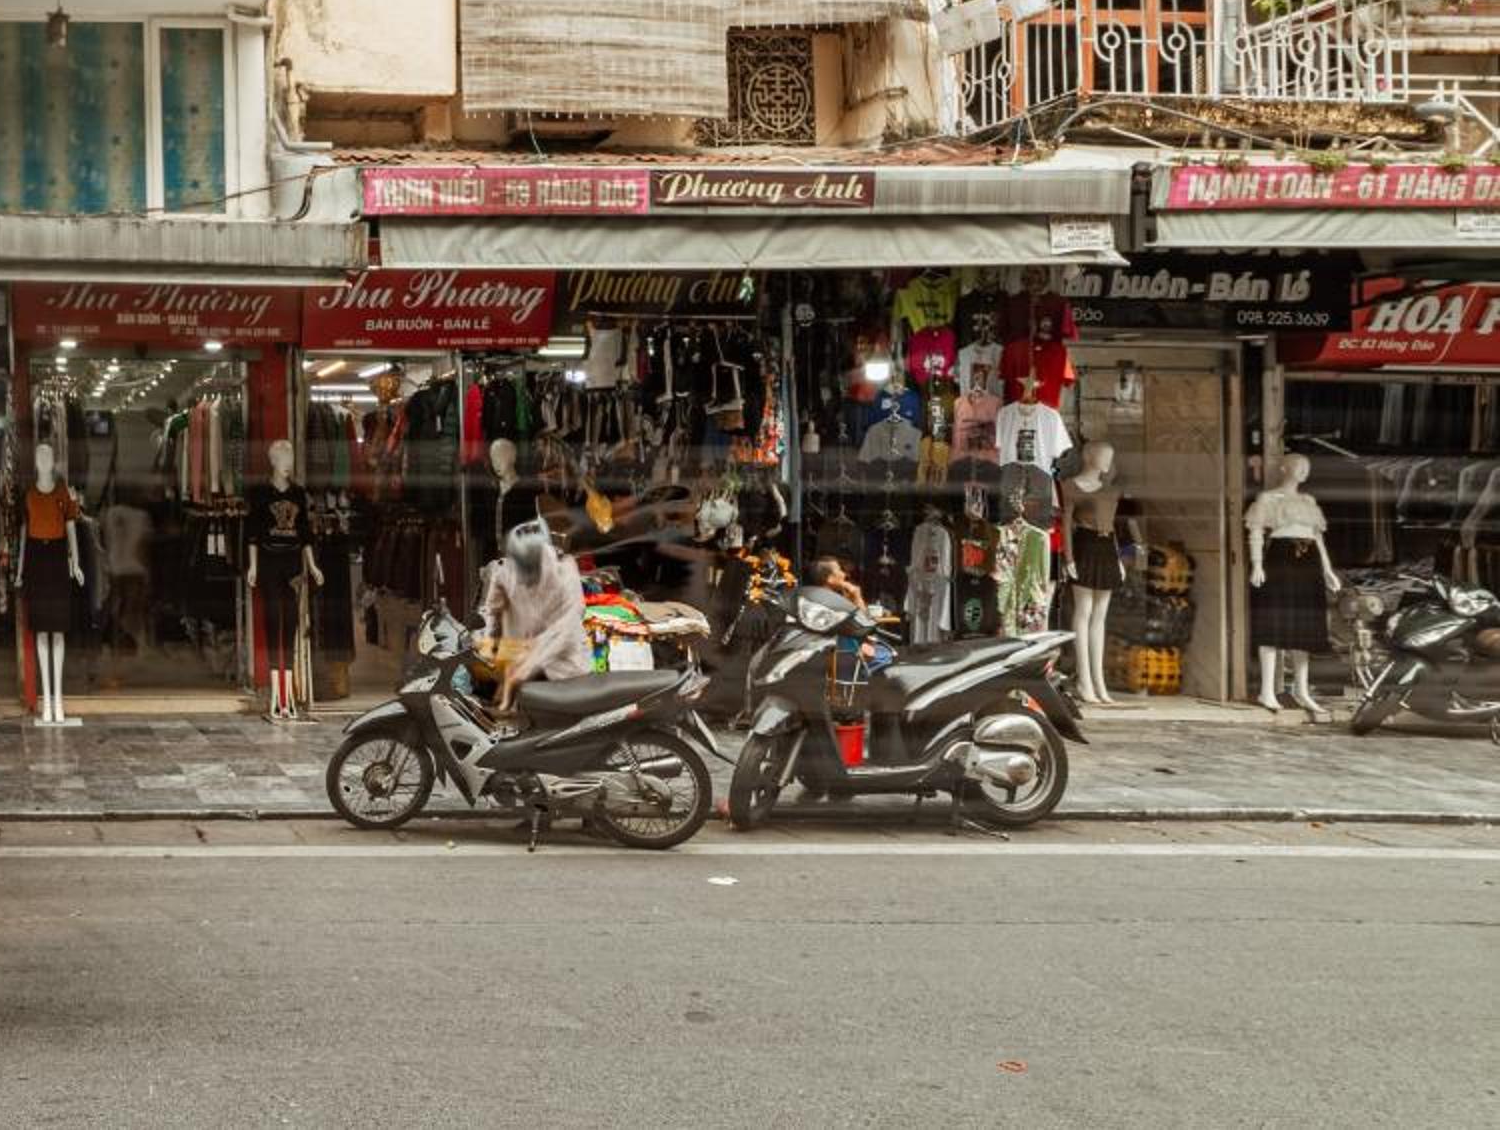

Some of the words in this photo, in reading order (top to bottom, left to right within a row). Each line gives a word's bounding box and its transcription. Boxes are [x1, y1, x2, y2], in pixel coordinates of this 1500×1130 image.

[659, 172, 784, 204] Phương
[794, 174, 864, 199] Anh
[1263, 172, 1334, 201] LOAN
[1357, 172, 1388, 201] 61
[1395, 168, 1468, 201] HÀNG
[1366, 294, 1466, 334] HOA
